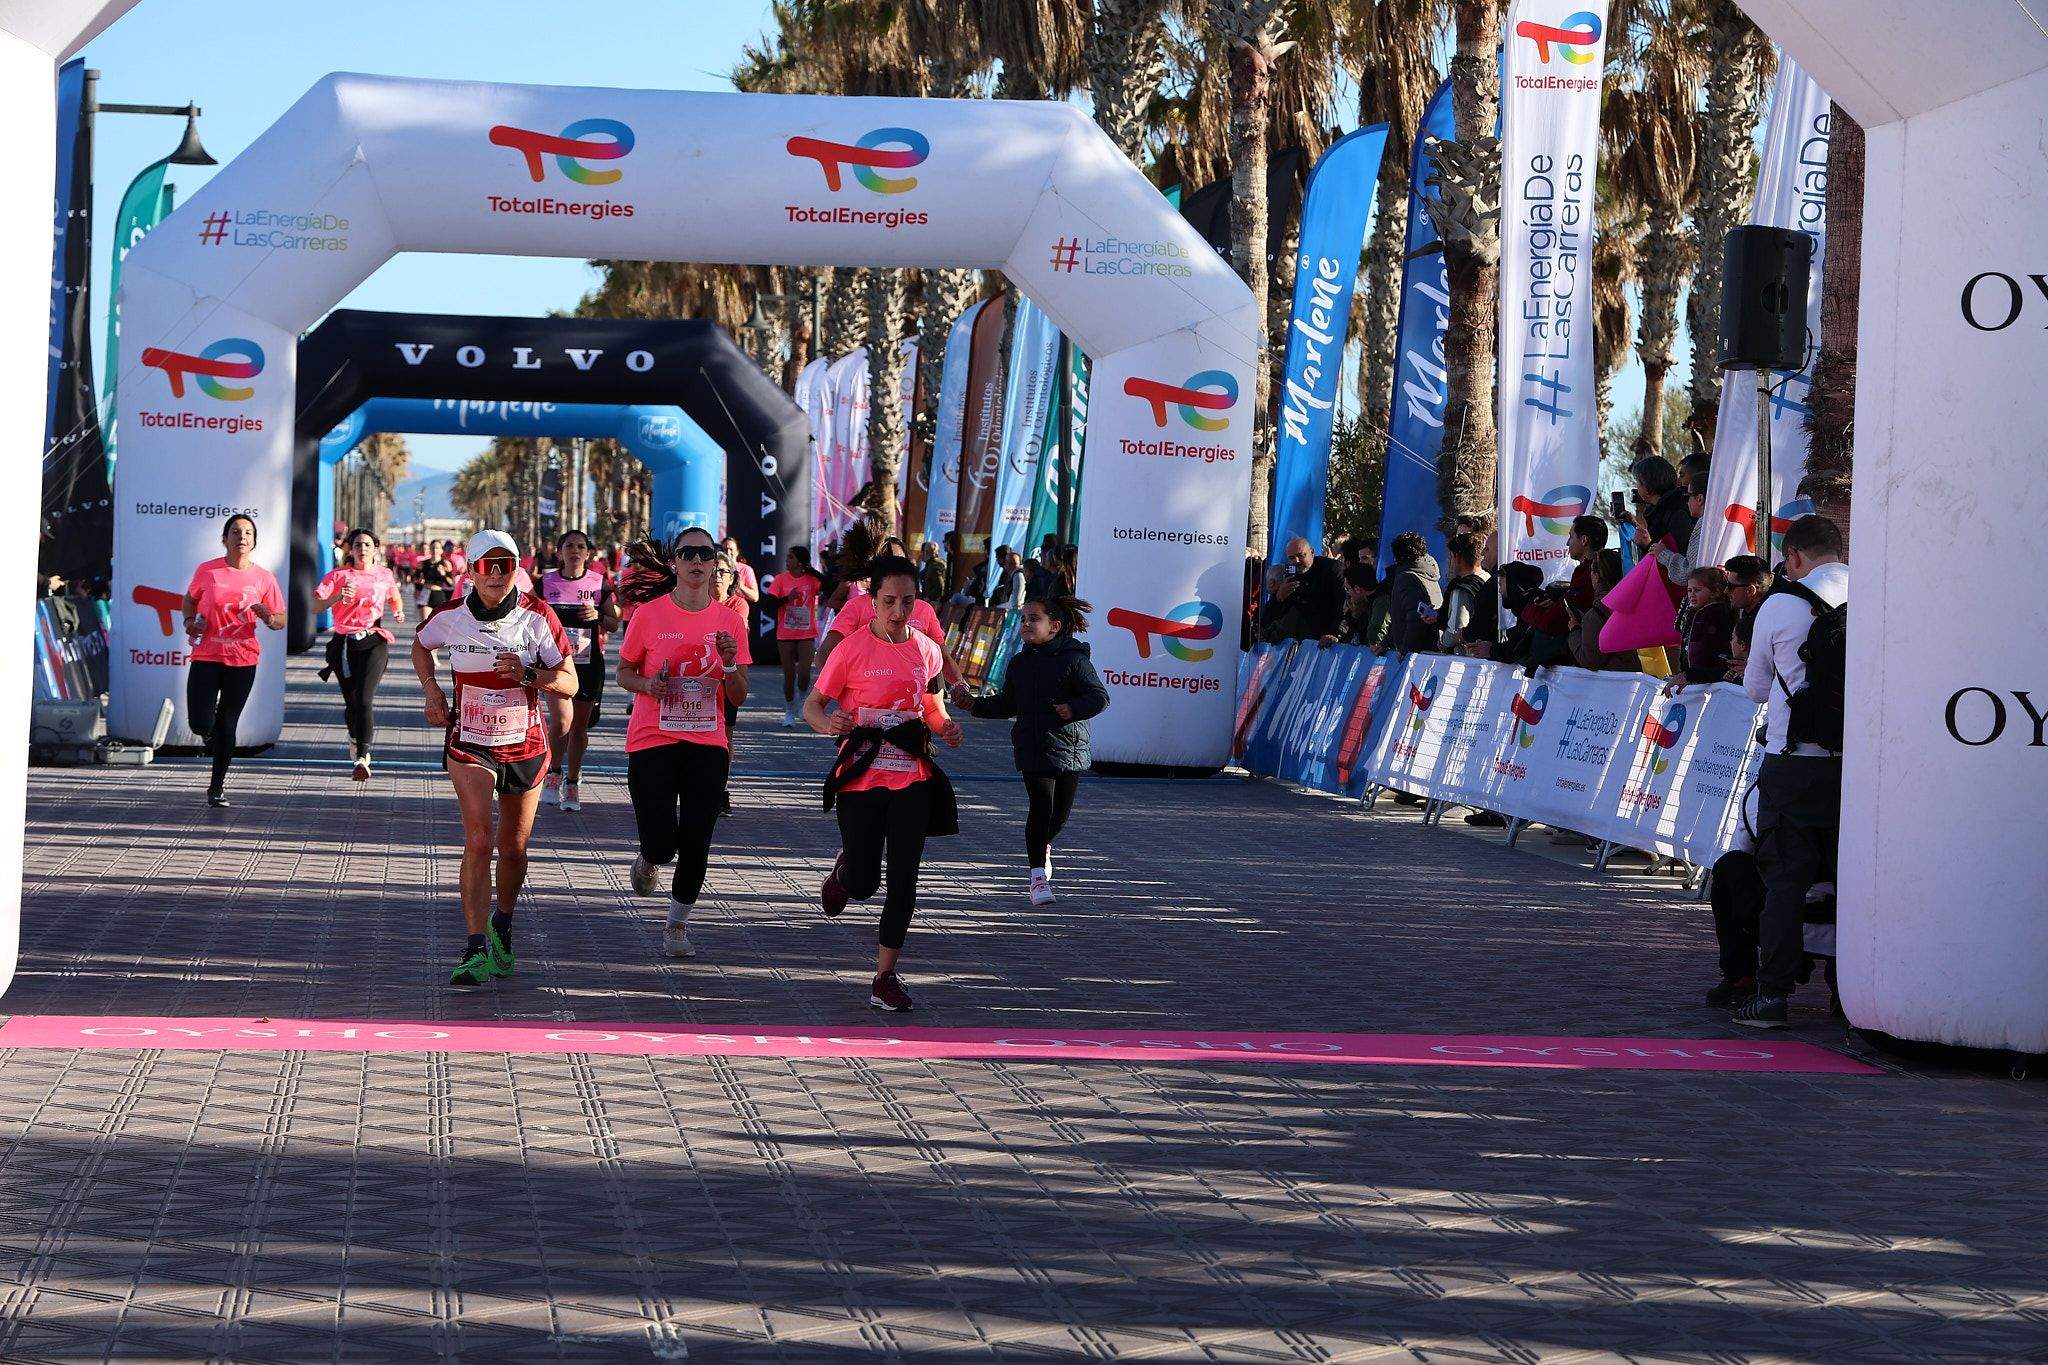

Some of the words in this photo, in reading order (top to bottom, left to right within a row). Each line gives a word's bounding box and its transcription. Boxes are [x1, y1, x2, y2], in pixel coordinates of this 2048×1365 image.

[1515, 76, 1599, 92] TotalEnergies
[488, 196, 634, 220] TotalEnergies
[785, 207, 929, 228] TotalEnergies
[234, 230, 348, 251] LasCarreras
[1549, 153, 1583, 359] LasCarreras
[1085, 257, 1192, 277] LasCarreras
[395, 343, 655, 372] VOLVO
[1284, 257, 1343, 446] Marlene
[139, 412, 263, 434] TotalEnergies
[1120, 440, 1235, 463] TotalEnergies
[759, 455, 778, 637] VOLVO
[1113, 527, 1229, 546] totalenergies.es
[577, 590, 595, 600] 30K
[657, 632, 684, 640] OYSHO
[864, 669, 893, 678] OYSHO
[1103, 670, 1220, 693] TotalEnergies
[682, 701, 702, 710] 016
[482, 714, 507, 724] 016
[80, 1026, 450, 1039] OYSHO
[544, 1030, 902, 1045] OYSHO
[993, 1038, 1342, 1052] OYSHO
[1430, 1045, 1774, 1059] OYSHO
